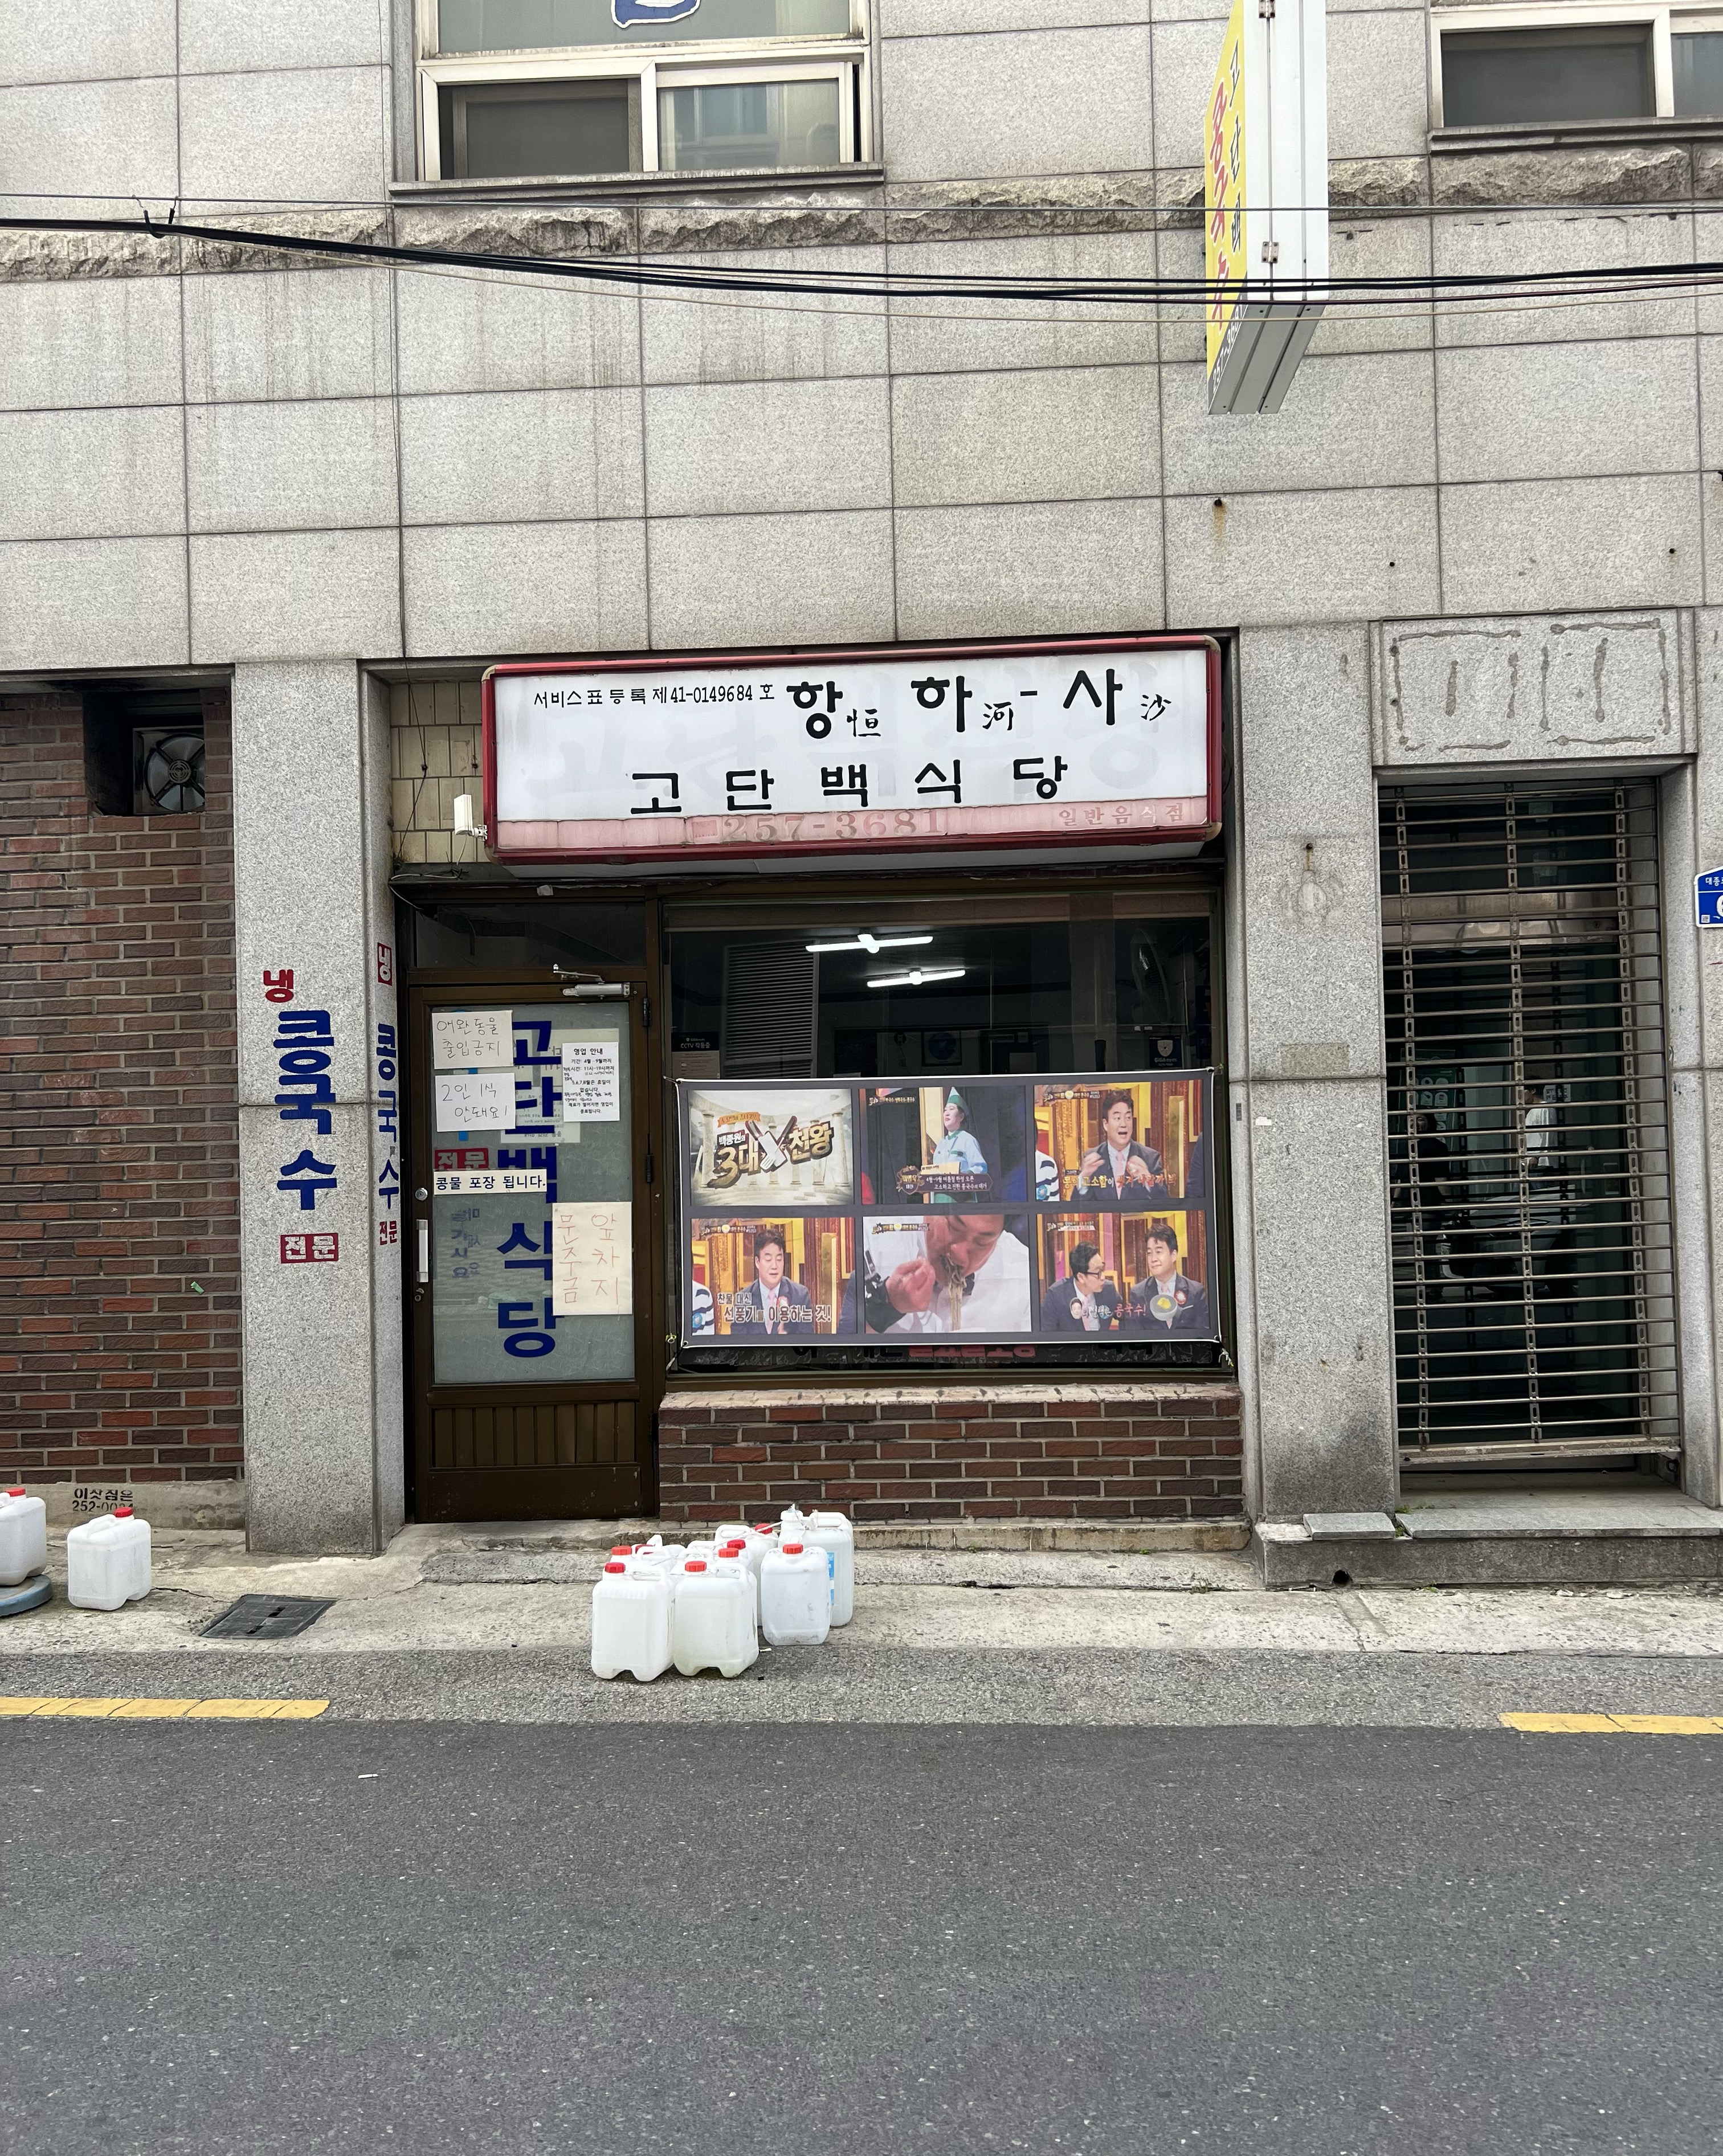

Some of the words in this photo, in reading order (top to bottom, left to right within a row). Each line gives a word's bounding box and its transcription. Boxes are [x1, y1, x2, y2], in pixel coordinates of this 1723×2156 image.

[724, 807, 945, 842] 257-3681
[273, 1010, 337, 1210] 콩국수
[377, 1023, 399, 1210] 콩국수
[435, 1177, 462, 1190] 콩물
[469, 1176, 496, 1190] 포장
[503, 1175, 546, 1189] 됩니다.
[379, 1220, 398, 1246] 전문
[284, 1234, 336, 1261] 전문
[717, 1292, 734, 1305] 찬물
[736, 1292, 752, 1305] 대신
[768, 1304, 814, 1323] 이용하는
